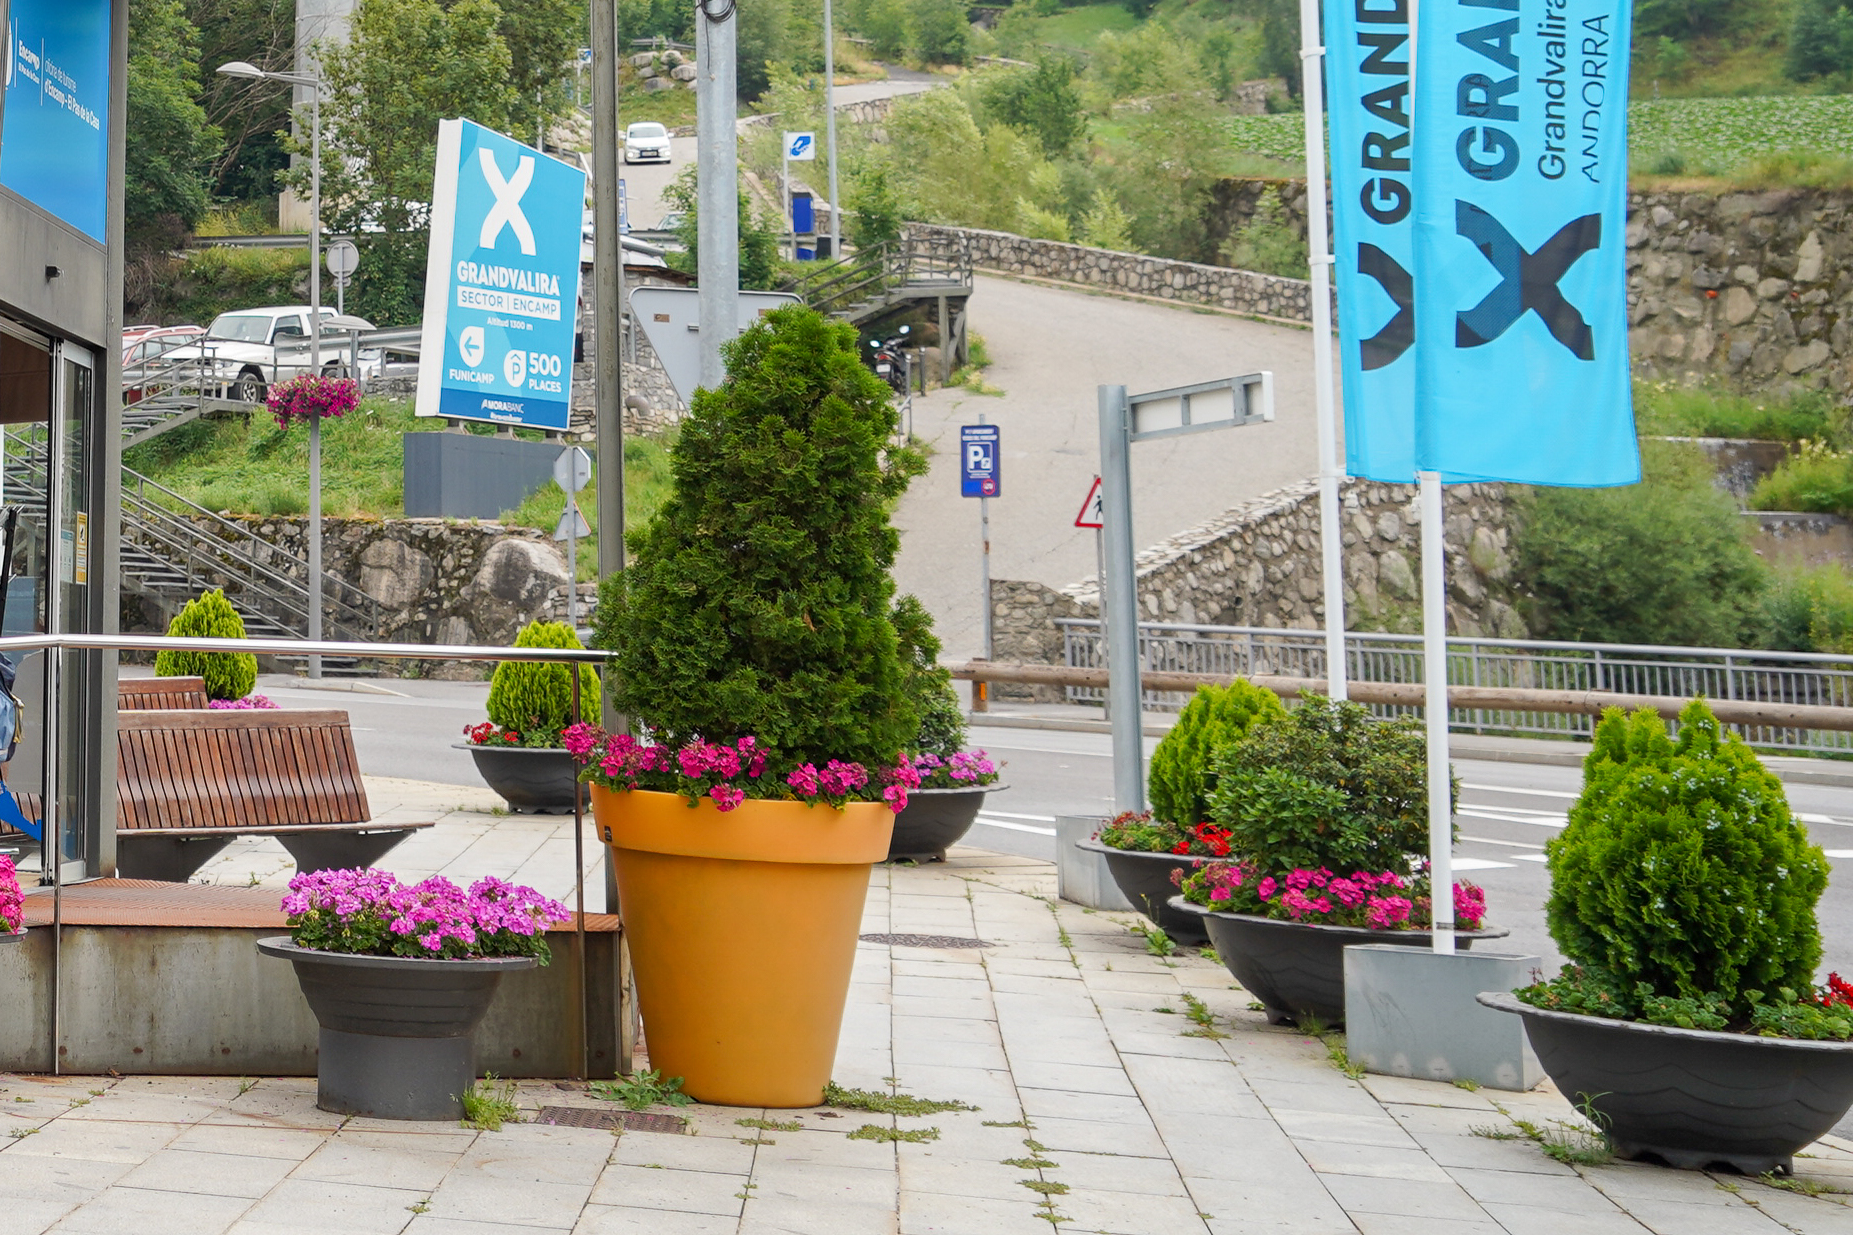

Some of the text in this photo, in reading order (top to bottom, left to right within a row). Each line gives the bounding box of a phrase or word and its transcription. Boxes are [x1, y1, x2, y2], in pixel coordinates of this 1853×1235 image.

[457, 260, 560, 296] GRANDVALIRA
[461, 291, 557, 315] SECTOR ENCAMP
[529, 352, 561, 377] 500
[449, 368, 562, 393] FUNICAMP PLACES
